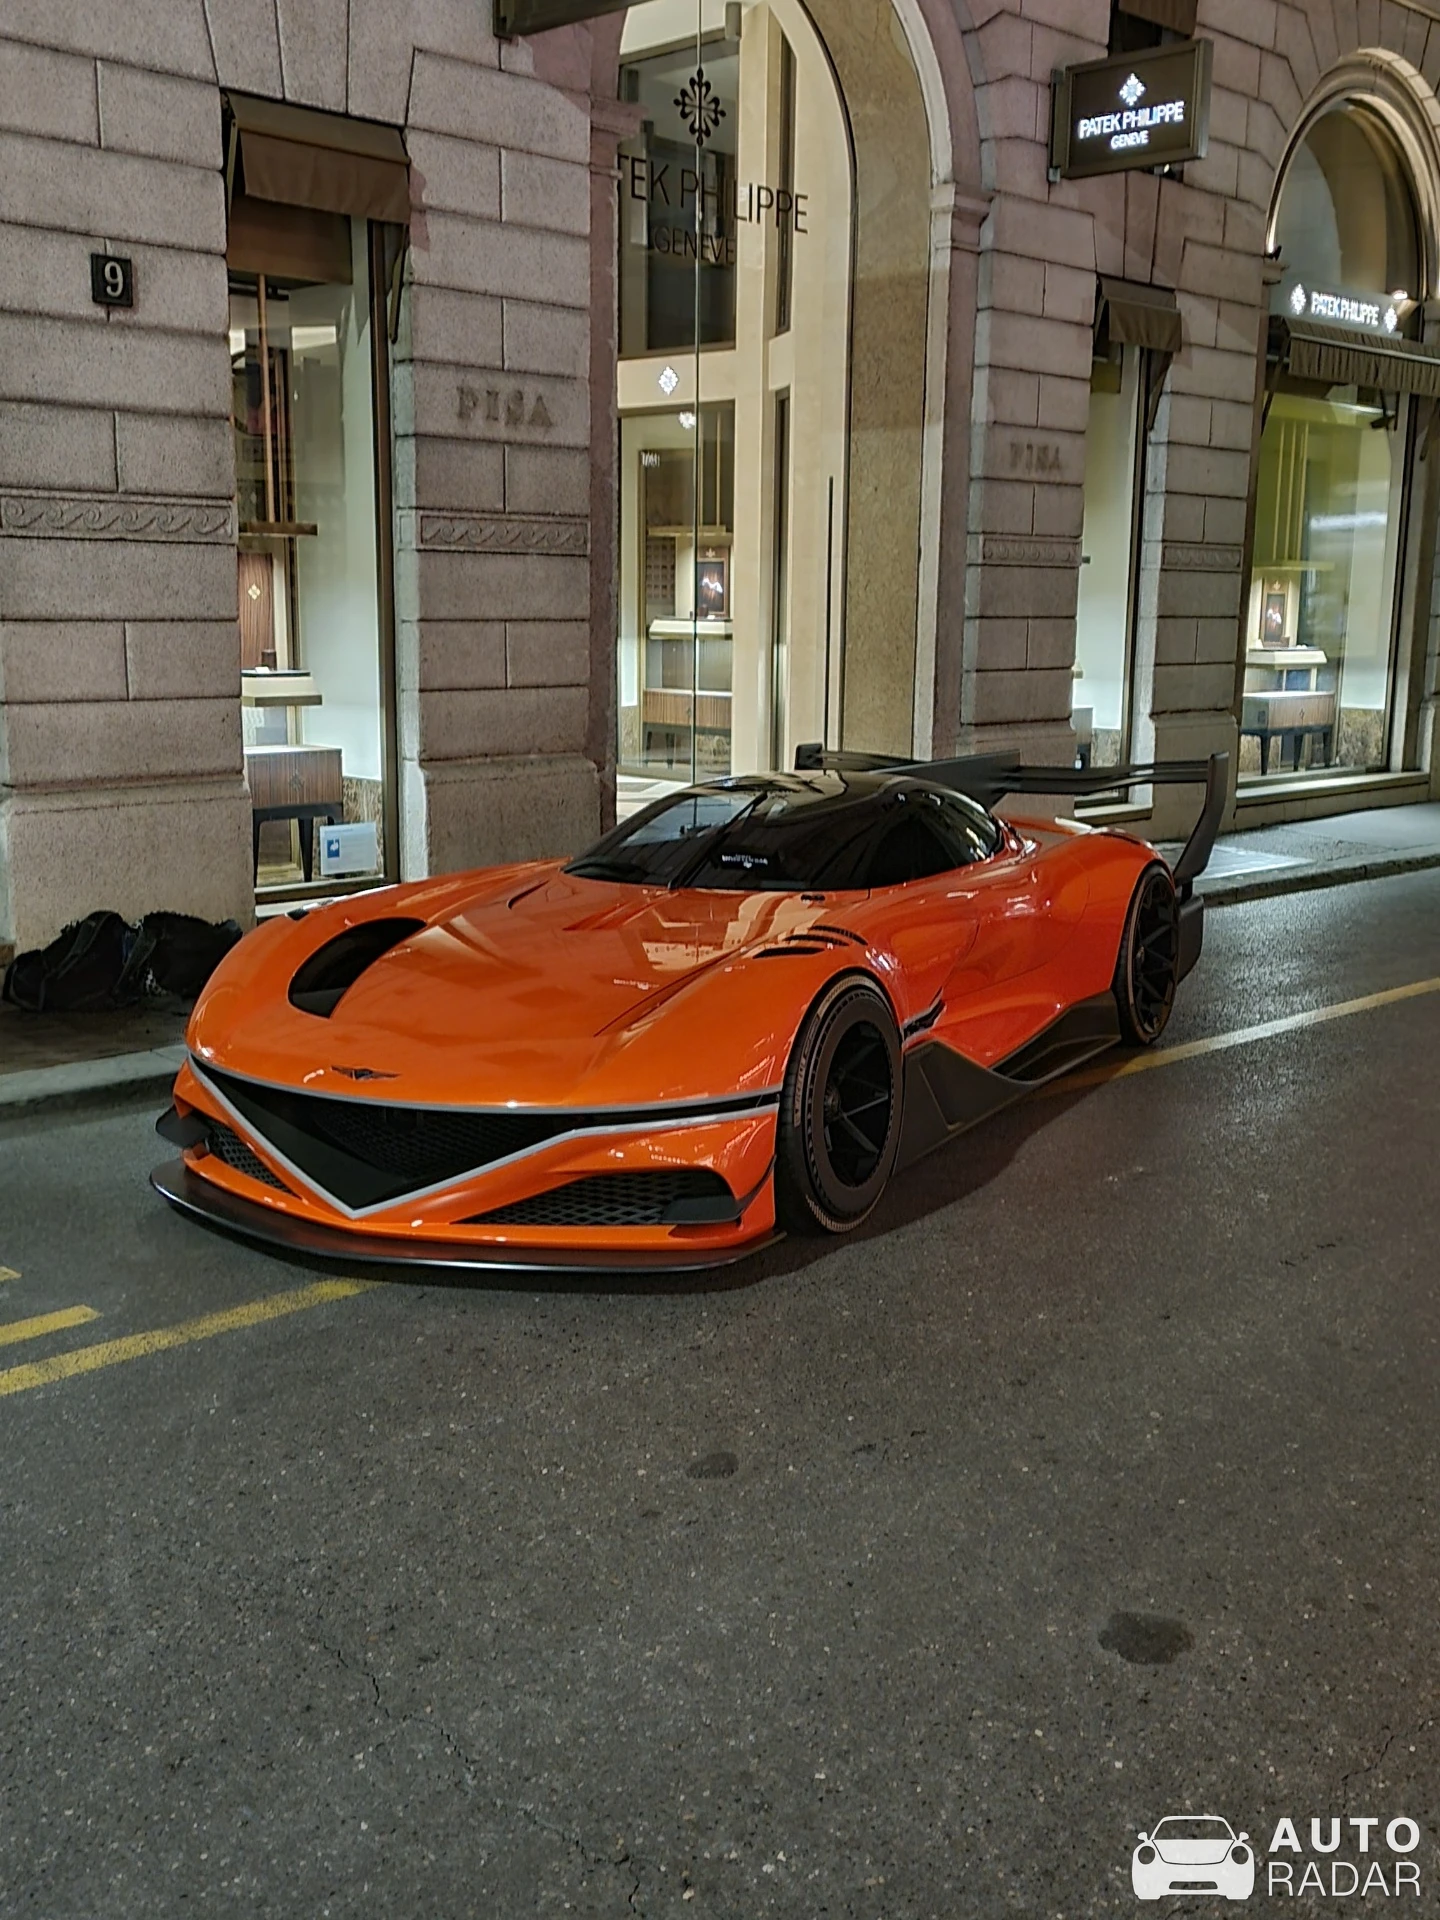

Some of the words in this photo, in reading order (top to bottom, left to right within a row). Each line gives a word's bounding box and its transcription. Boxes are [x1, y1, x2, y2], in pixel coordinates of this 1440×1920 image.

[1079, 113, 1121, 139] PATEK
[1122, 101, 1184, 129] PHILIPPE
[1110, 130, 1149, 149] GENEVE
[617, 153, 670, 206] TEK
[104, 261, 123, 297] 9
[1311, 291, 1340, 317] PATEK
[1341, 298, 1380, 325] PHILIPPE
[457, 384, 554, 428] PISA
